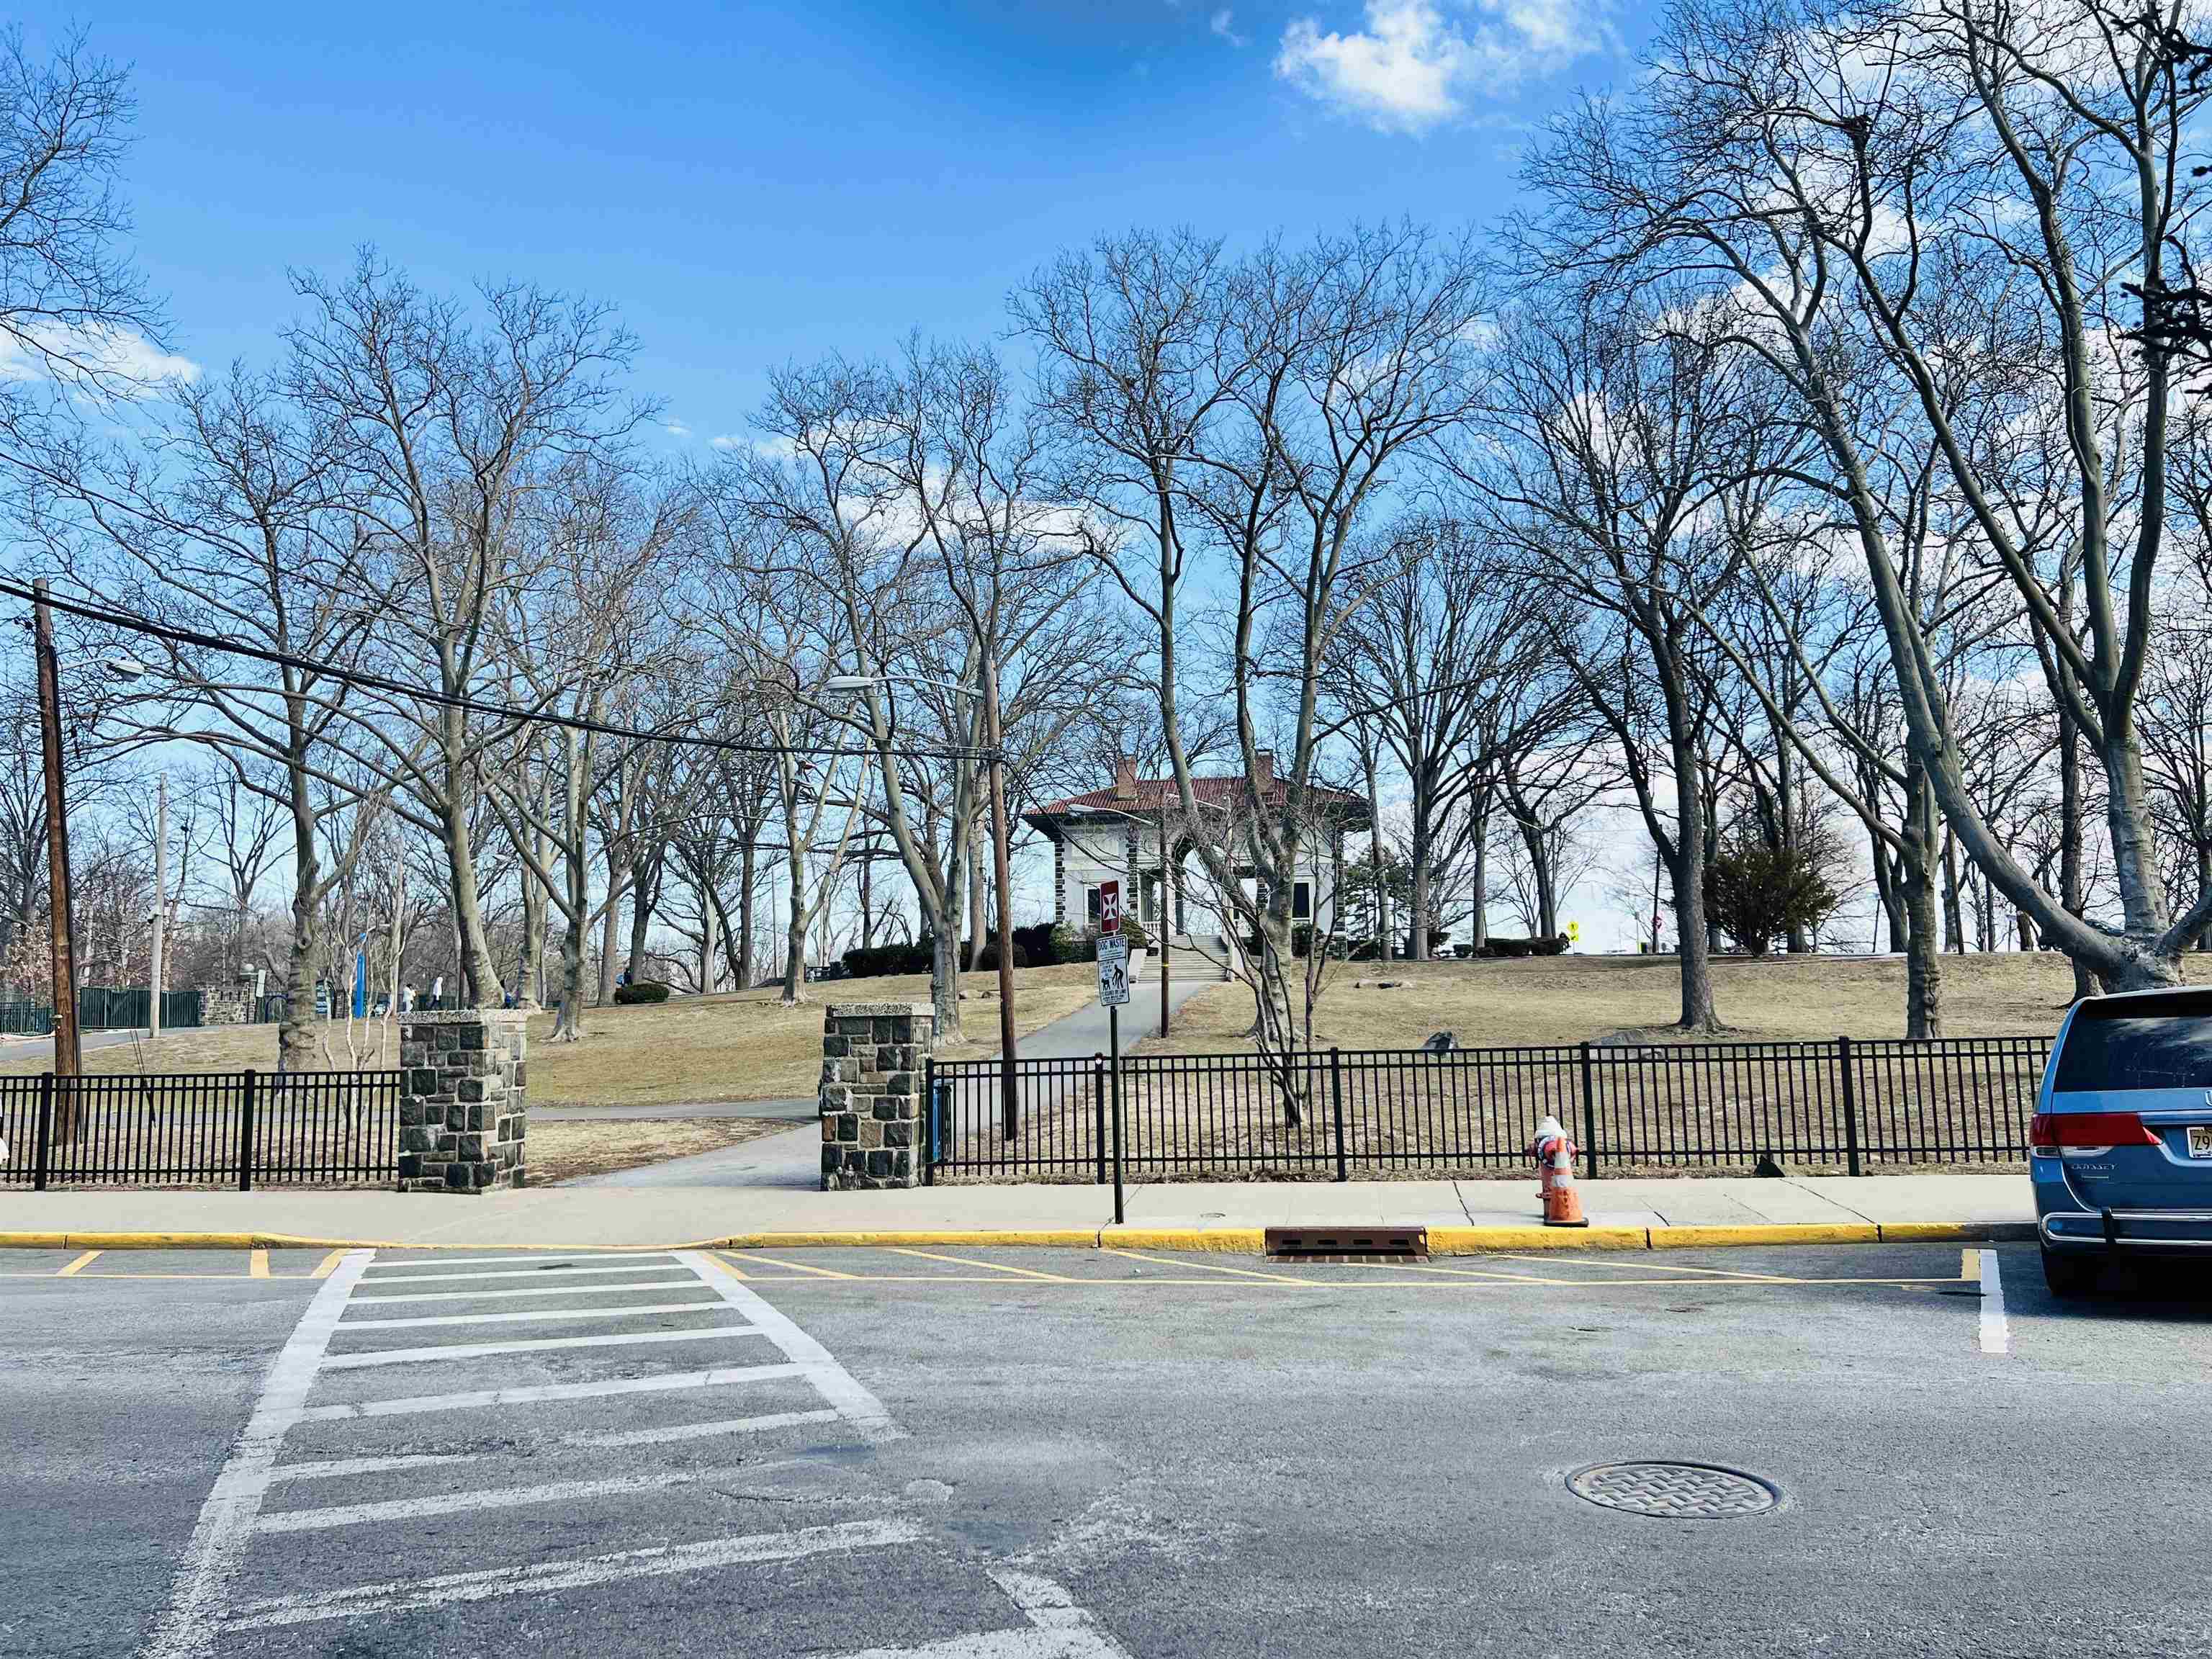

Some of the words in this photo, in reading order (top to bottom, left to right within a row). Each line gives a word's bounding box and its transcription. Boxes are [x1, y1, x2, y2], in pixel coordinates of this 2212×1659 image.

[1099, 940, 1107, 950] DOG
[1110, 938, 1125, 949] WASTE
[2193, 1135, 2212, 1151] Z9
